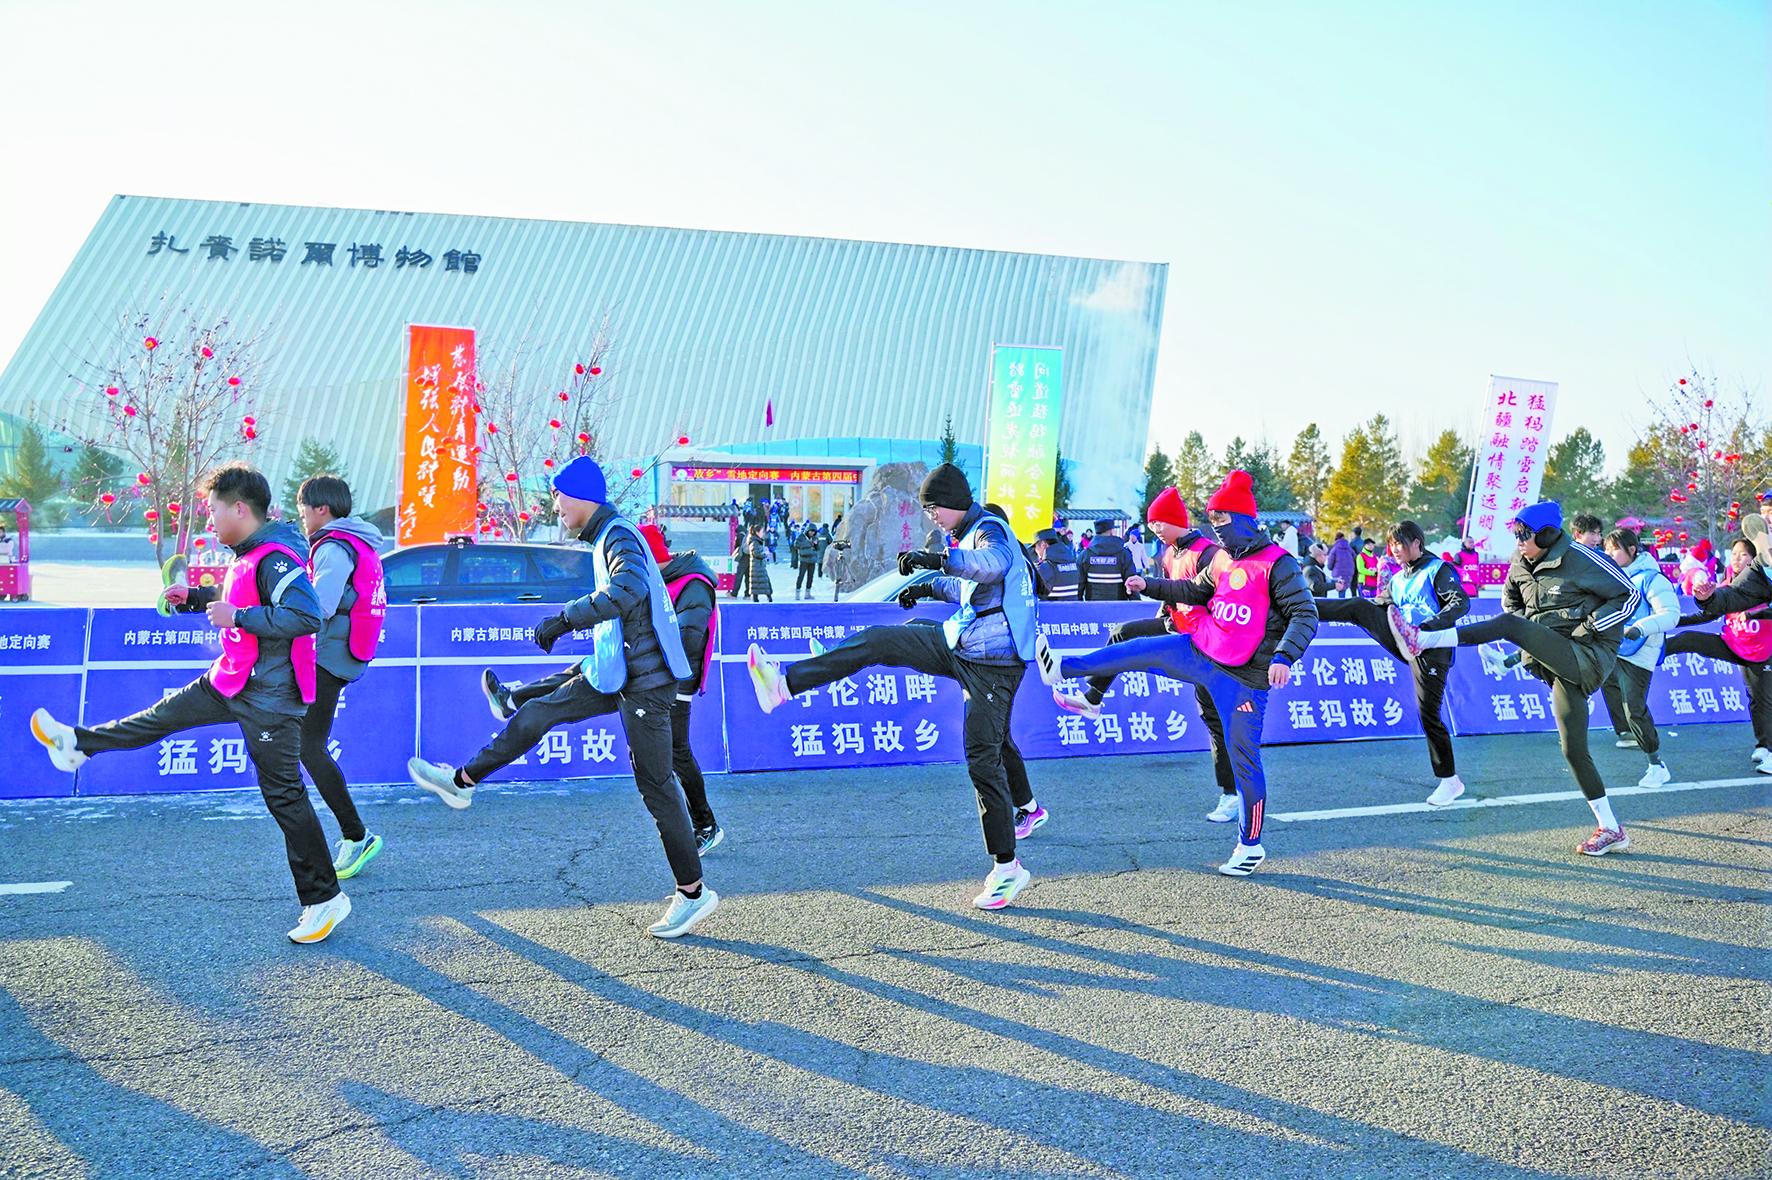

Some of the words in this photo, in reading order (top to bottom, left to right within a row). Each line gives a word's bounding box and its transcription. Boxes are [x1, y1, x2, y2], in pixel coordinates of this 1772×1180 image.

[124, 630, 222, 646] 内蒙古第四届中
[1052, 671, 1184, 698] 呼湖畔
[1669, 685, 1745, 715] 猛犸故
[1056, 709, 1187, 746] 猛犸故乡
[1287, 697, 1404, 730] 猛犸故乡
[508, 728, 618, 765] 犸故
[790, 718, 939, 758] 猛犸故乡
